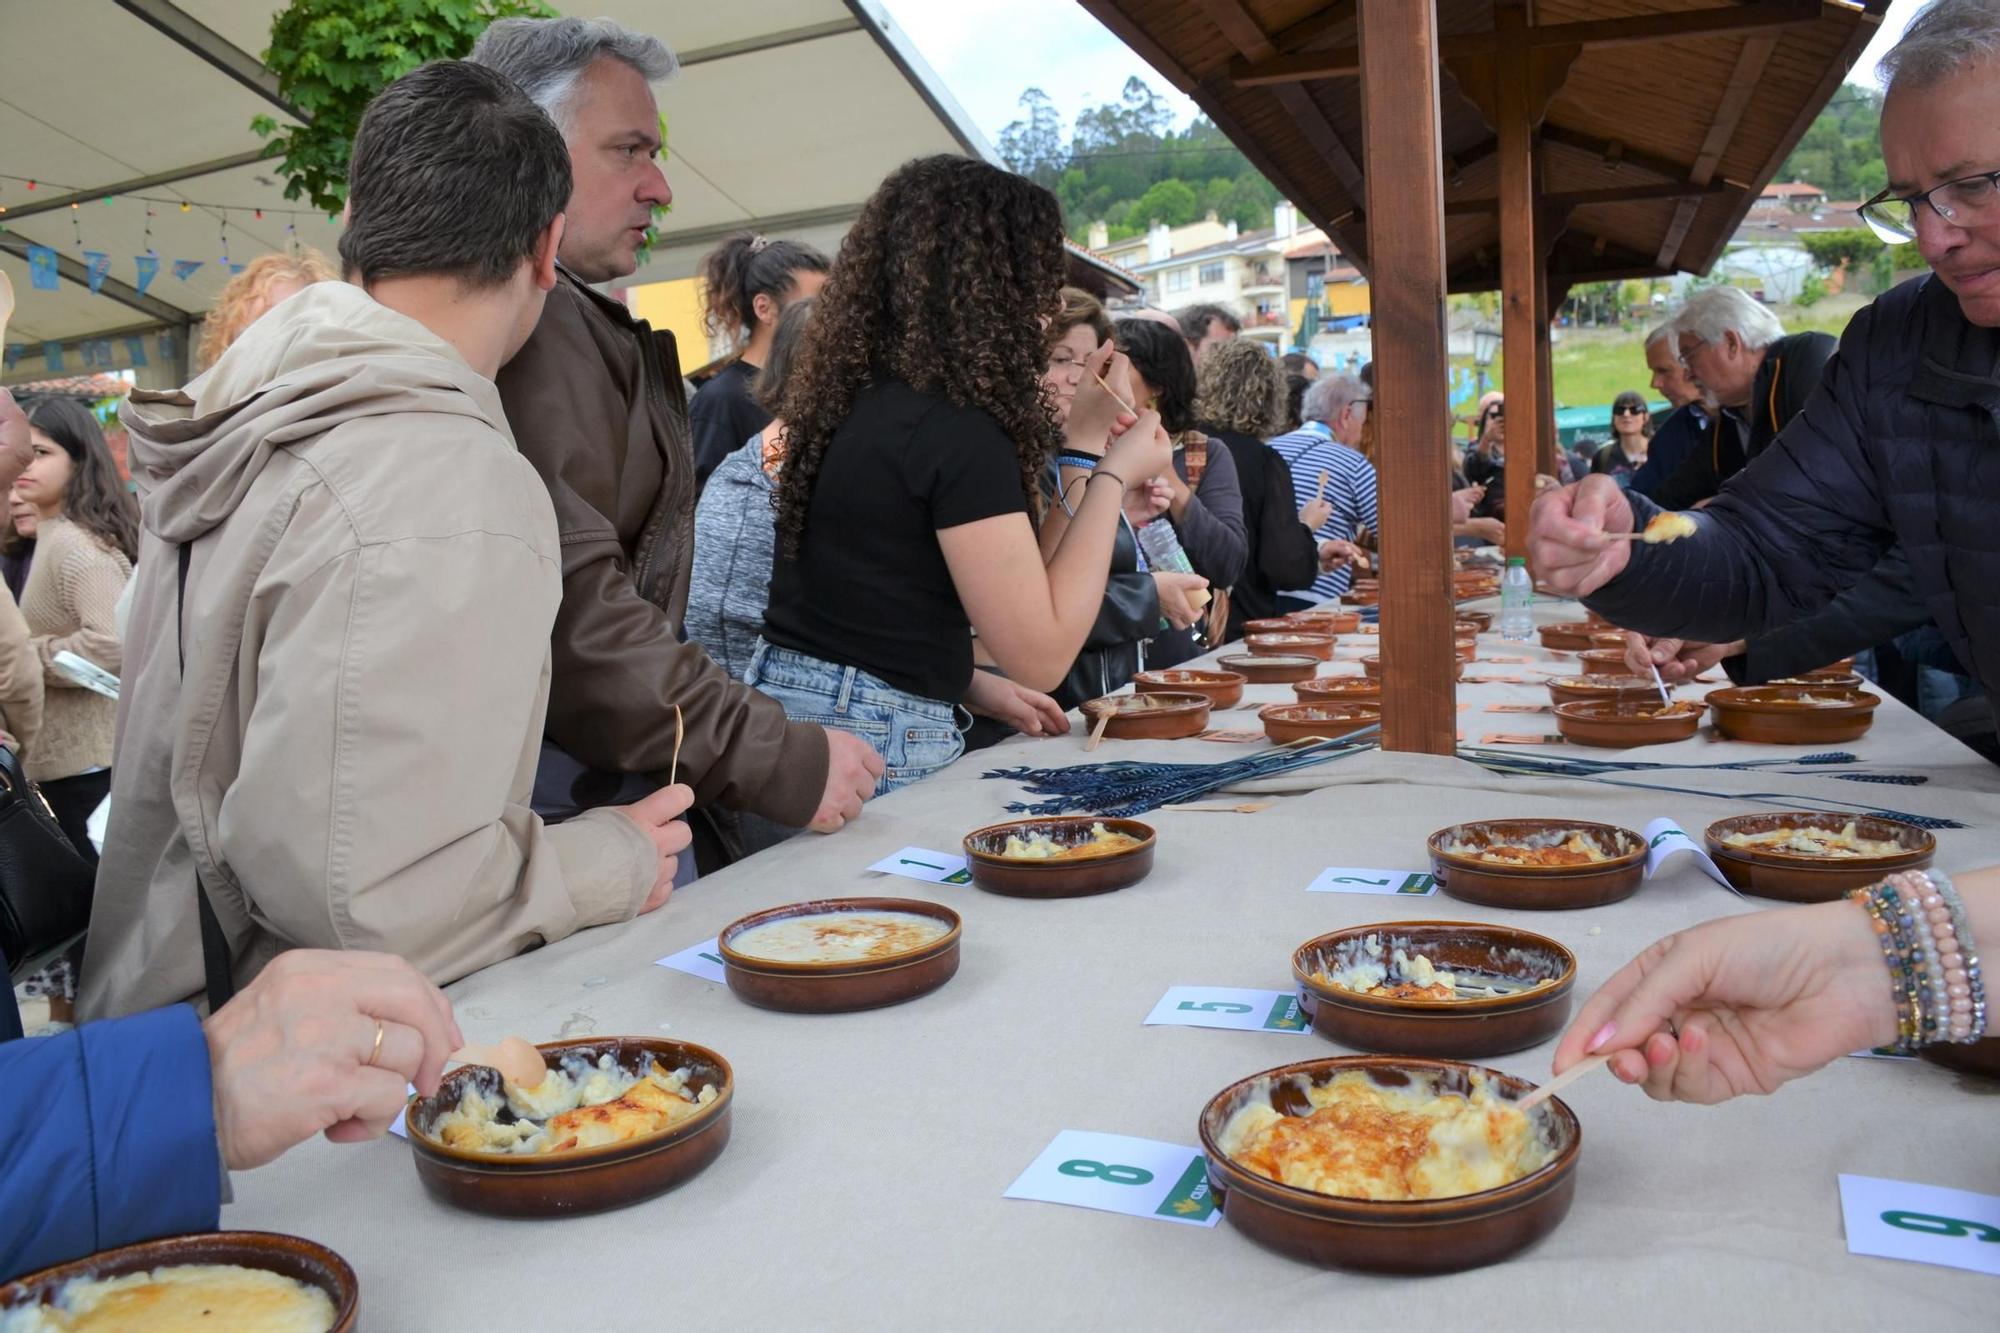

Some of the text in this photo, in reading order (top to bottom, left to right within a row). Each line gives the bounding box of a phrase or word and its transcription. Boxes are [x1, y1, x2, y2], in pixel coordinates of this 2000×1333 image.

[900, 859, 946, 870] 1
[1332, 876, 1391, 885] 2
[1177, 1001, 1253, 1014] 5
[1058, 1159, 1154, 1185] 8
[1880, 1210, 2000, 1243] 9
